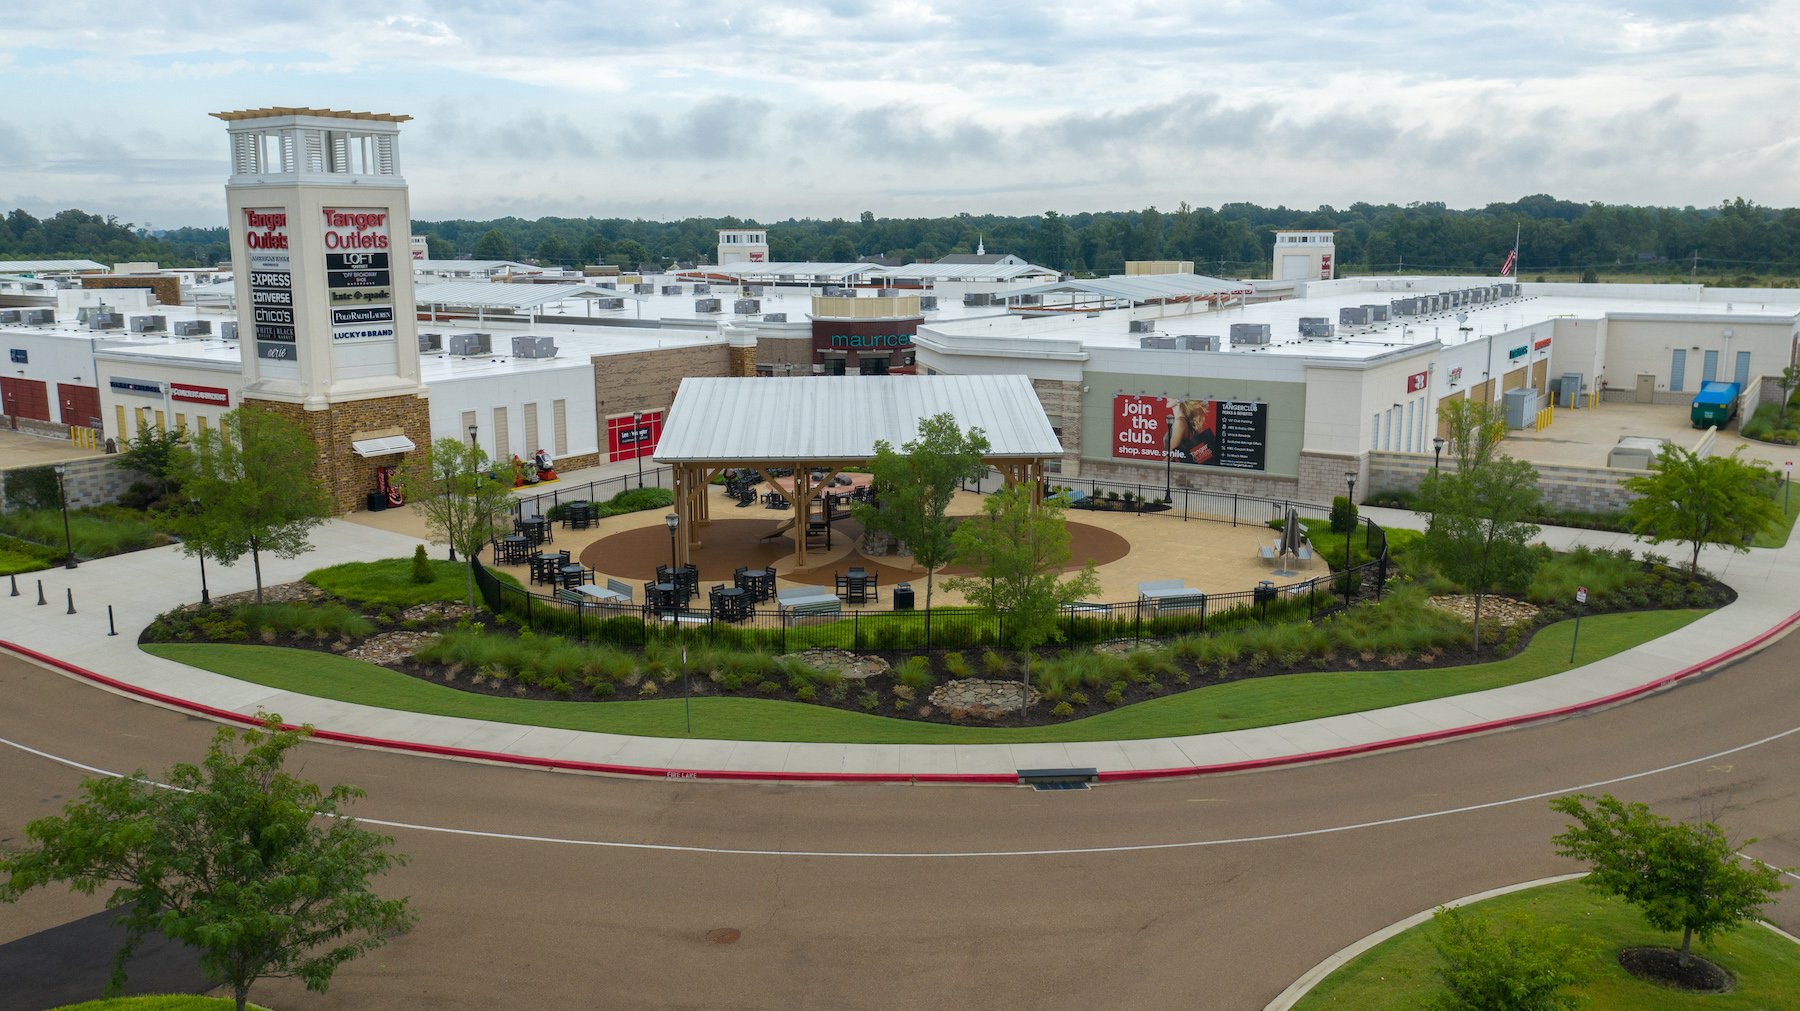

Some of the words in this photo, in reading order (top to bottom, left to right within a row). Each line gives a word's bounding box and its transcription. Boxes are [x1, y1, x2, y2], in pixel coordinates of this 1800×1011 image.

[245, 210, 286, 231] Tanger
[323, 210, 386, 231] Tanger
[247, 231, 288, 249] Outlets
[325, 231, 388, 249] Outlets
[343, 253, 374, 265] LOFT
[251, 273, 290, 286] EXPRESS
[252, 292, 291, 303] CONVERSE
[334, 331, 360, 340] LUCKY
[367, 329, 393, 337] BRAND
[1122, 399, 1152, 416] join
[1132, 415, 1158, 430] the
[1119, 429, 1155, 444] club.
[1119, 445, 1140, 455] shop.
[1141, 448, 1161, 456] save.
